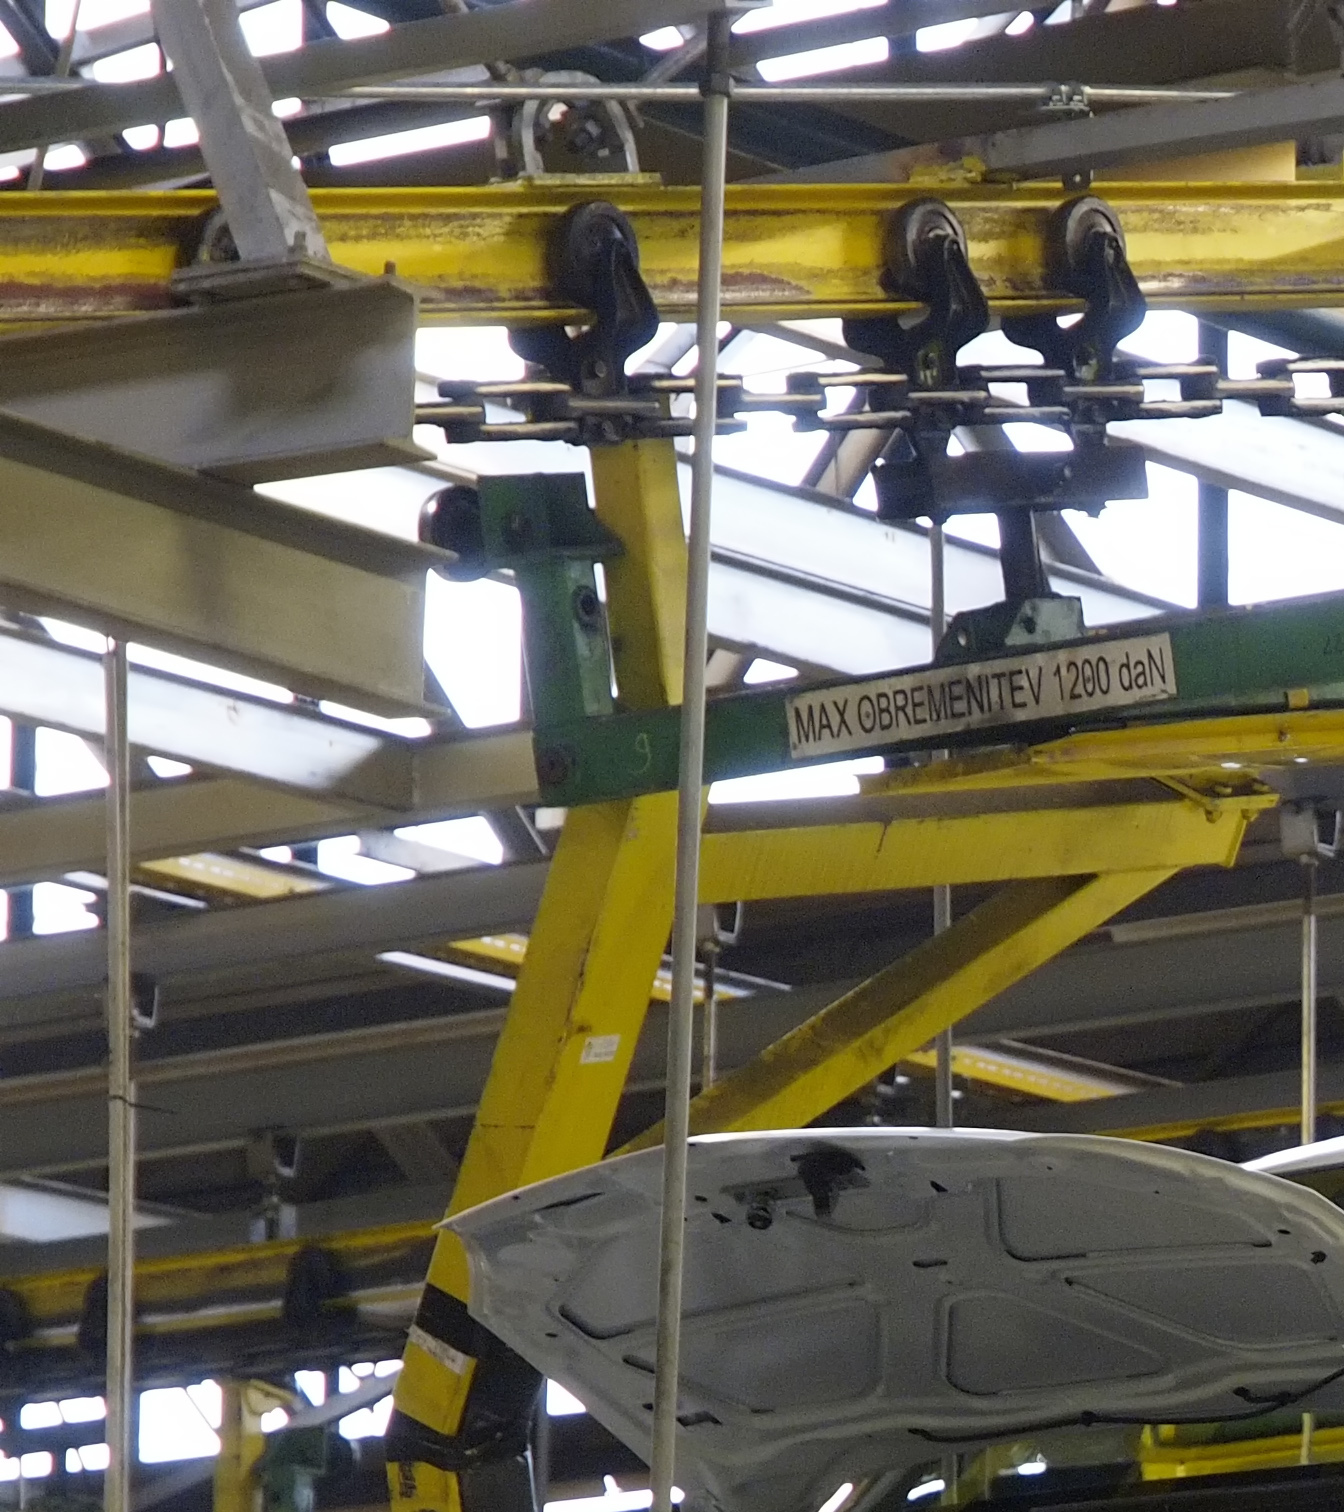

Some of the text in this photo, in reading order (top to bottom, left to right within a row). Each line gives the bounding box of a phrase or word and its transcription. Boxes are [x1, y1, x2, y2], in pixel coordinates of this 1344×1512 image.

[794, 647, 1166, 745] MAX OBREMENITEV 1200 daN
